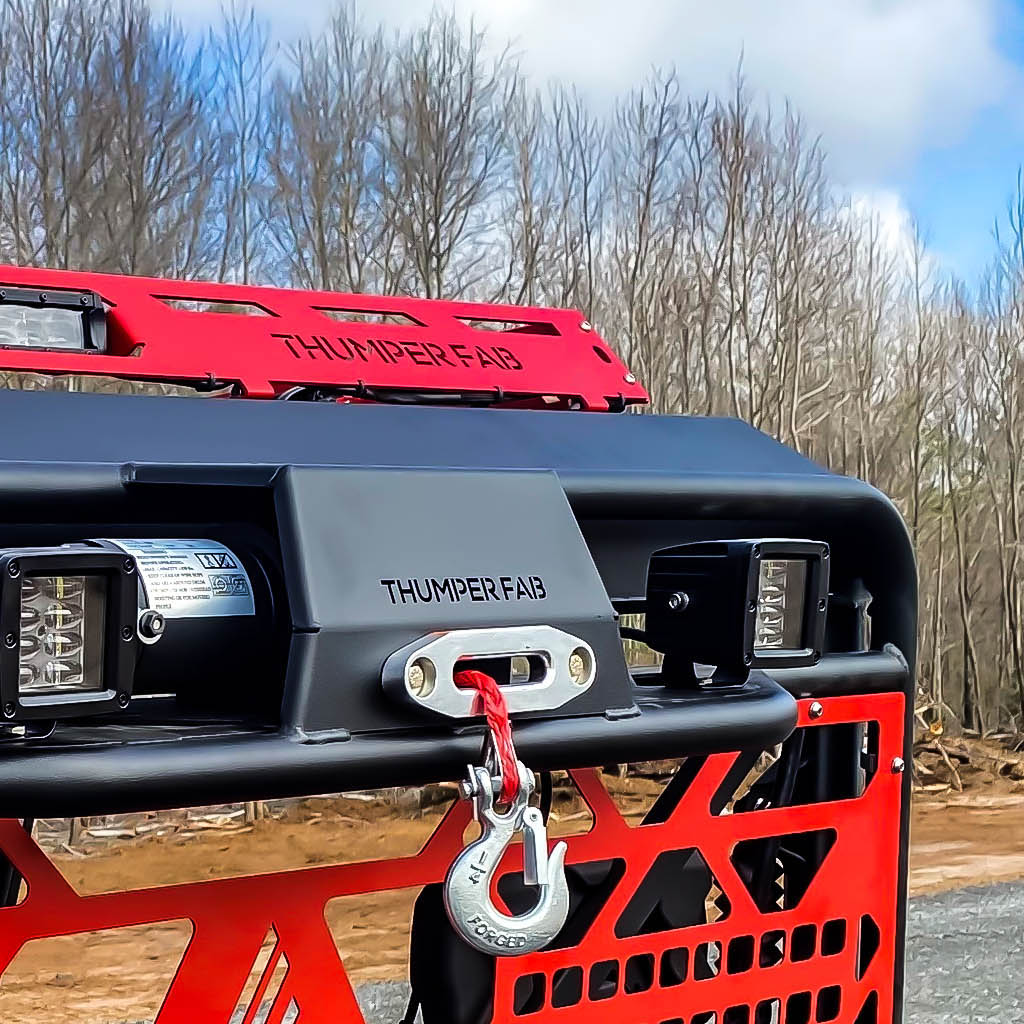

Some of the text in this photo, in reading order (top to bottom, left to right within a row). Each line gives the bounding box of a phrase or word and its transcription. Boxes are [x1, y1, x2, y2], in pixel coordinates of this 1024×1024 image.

[270, 333, 524, 370] THUMPER FAB
[381, 576, 547, 604] THUMPER FAB
